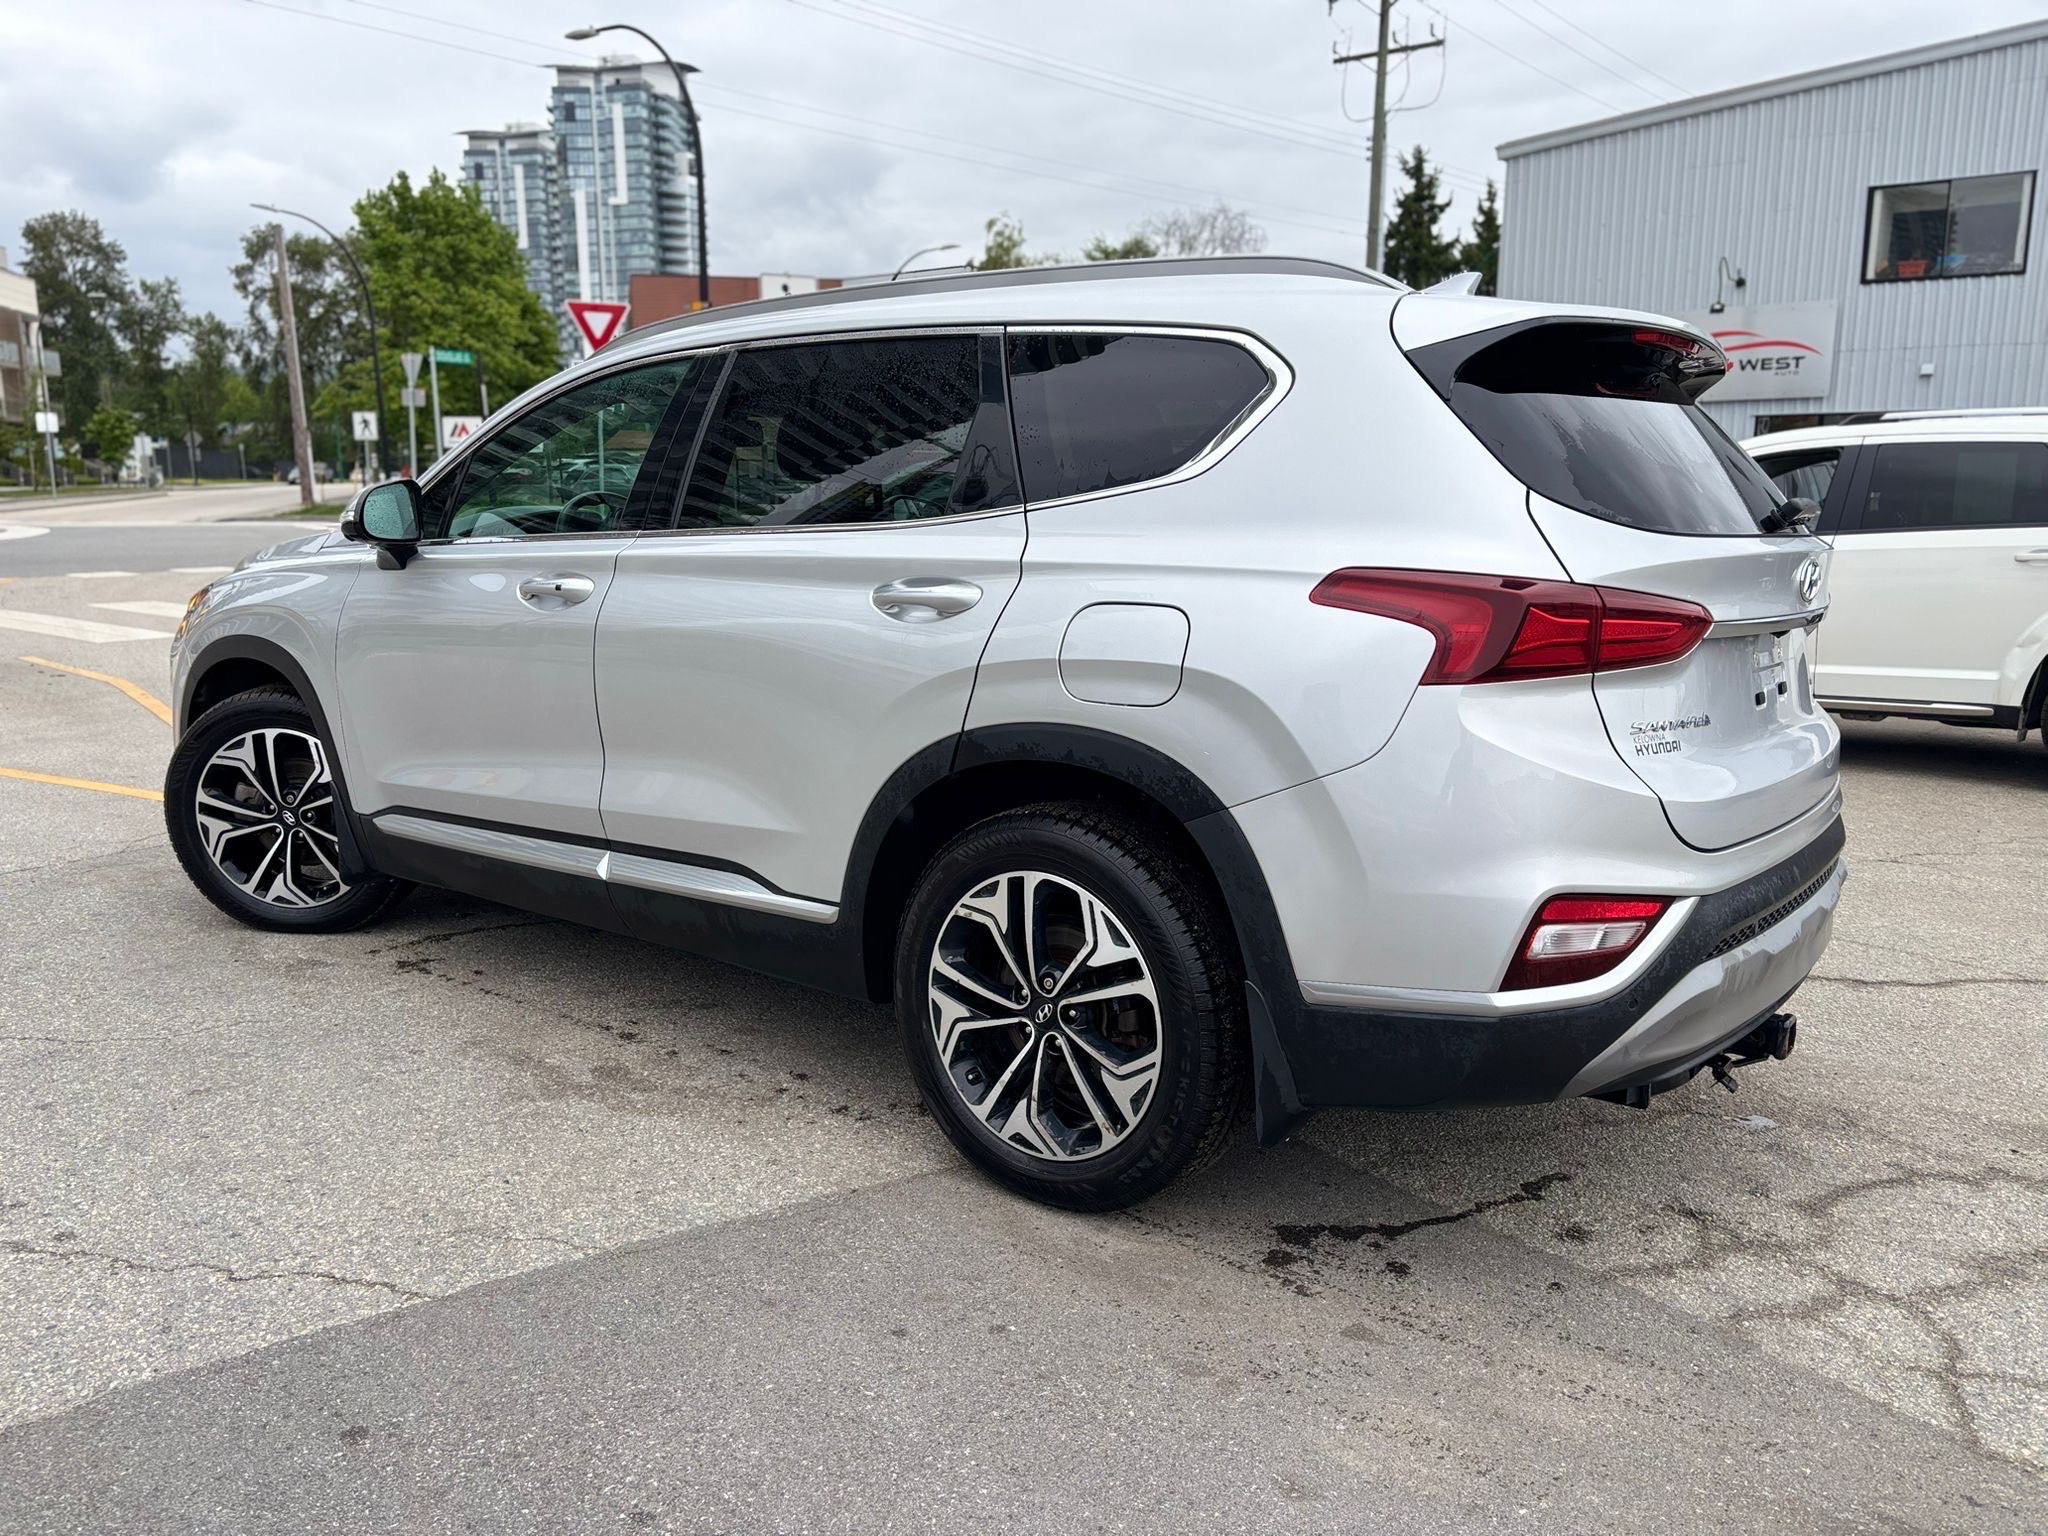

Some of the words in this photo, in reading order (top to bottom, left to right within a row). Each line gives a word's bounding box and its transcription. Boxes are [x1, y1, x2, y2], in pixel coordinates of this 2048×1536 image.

[1739, 355, 1806, 371] WEST
[1633, 733, 1666, 744] KELOWNA
[1634, 740, 1682, 757] HYUNDAI
